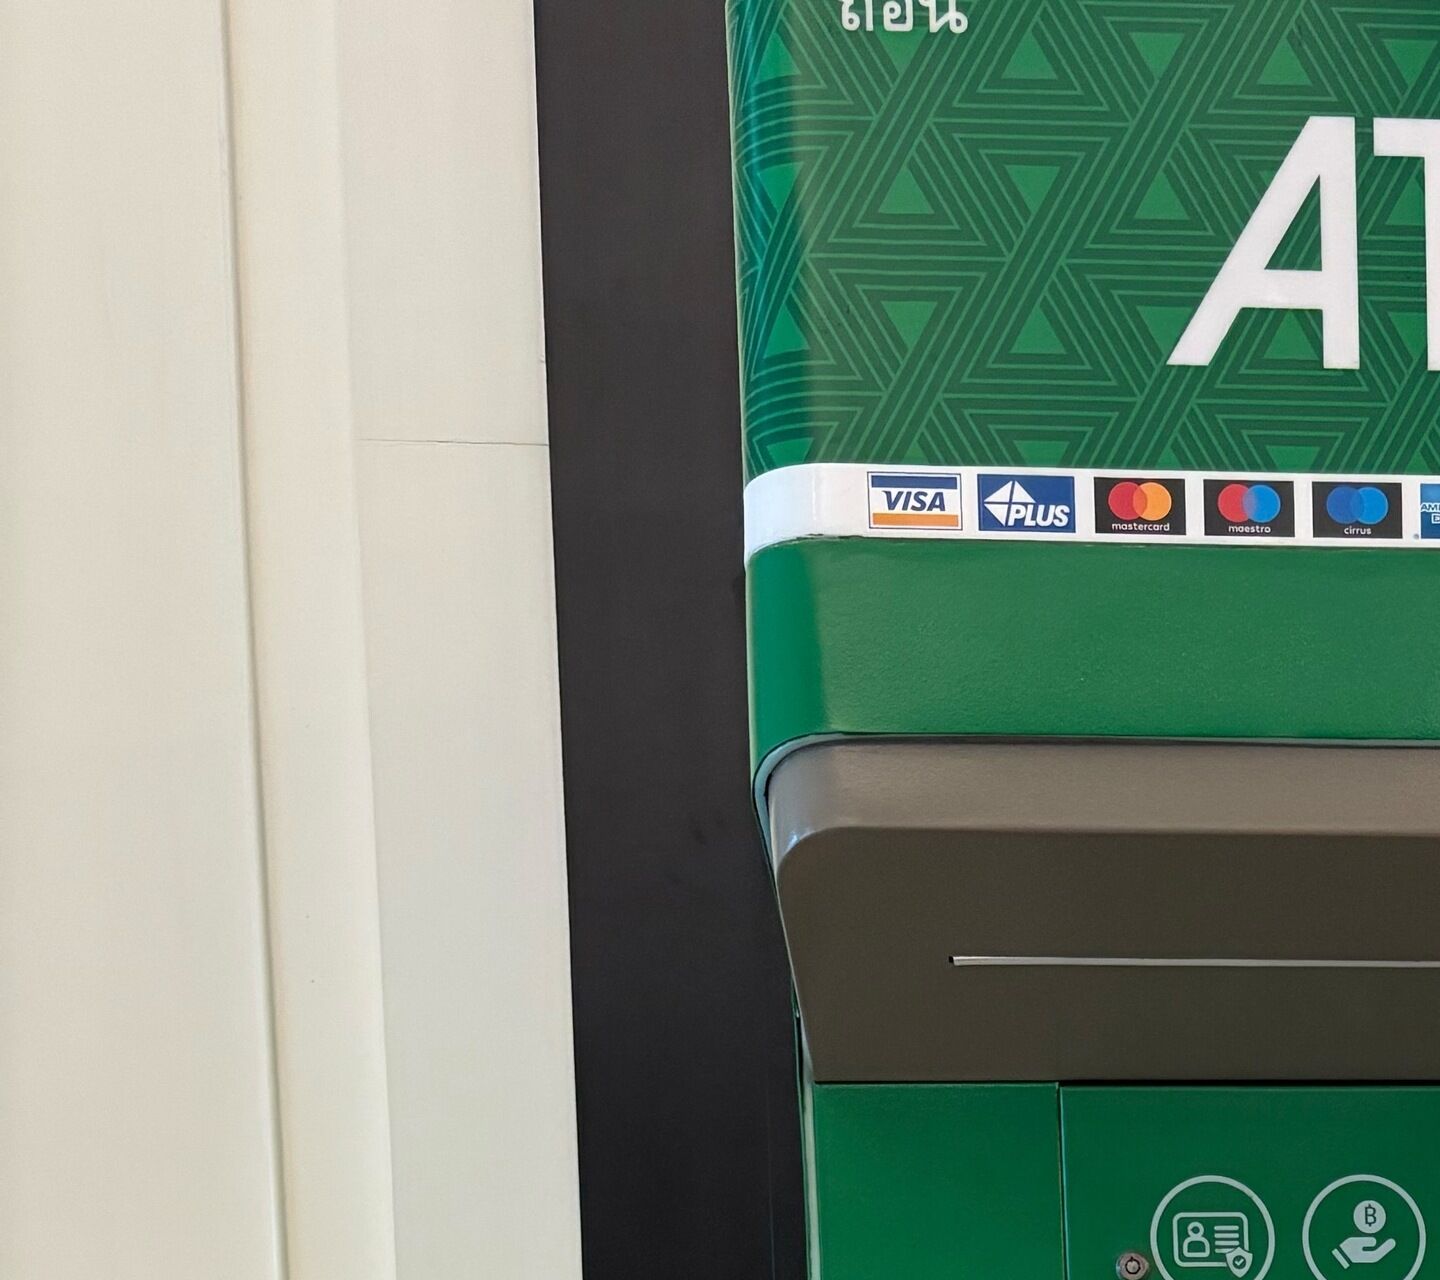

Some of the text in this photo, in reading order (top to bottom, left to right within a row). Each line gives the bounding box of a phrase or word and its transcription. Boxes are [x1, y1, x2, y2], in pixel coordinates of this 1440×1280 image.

[881, 490, 946, 512] VISA
[1005, 503, 1071, 527] PLUS
[1111, 521, 1170, 533] mastercard
[1228, 524, 1271, 534] maestro
[1344, 525, 1372, 536] cirrus
